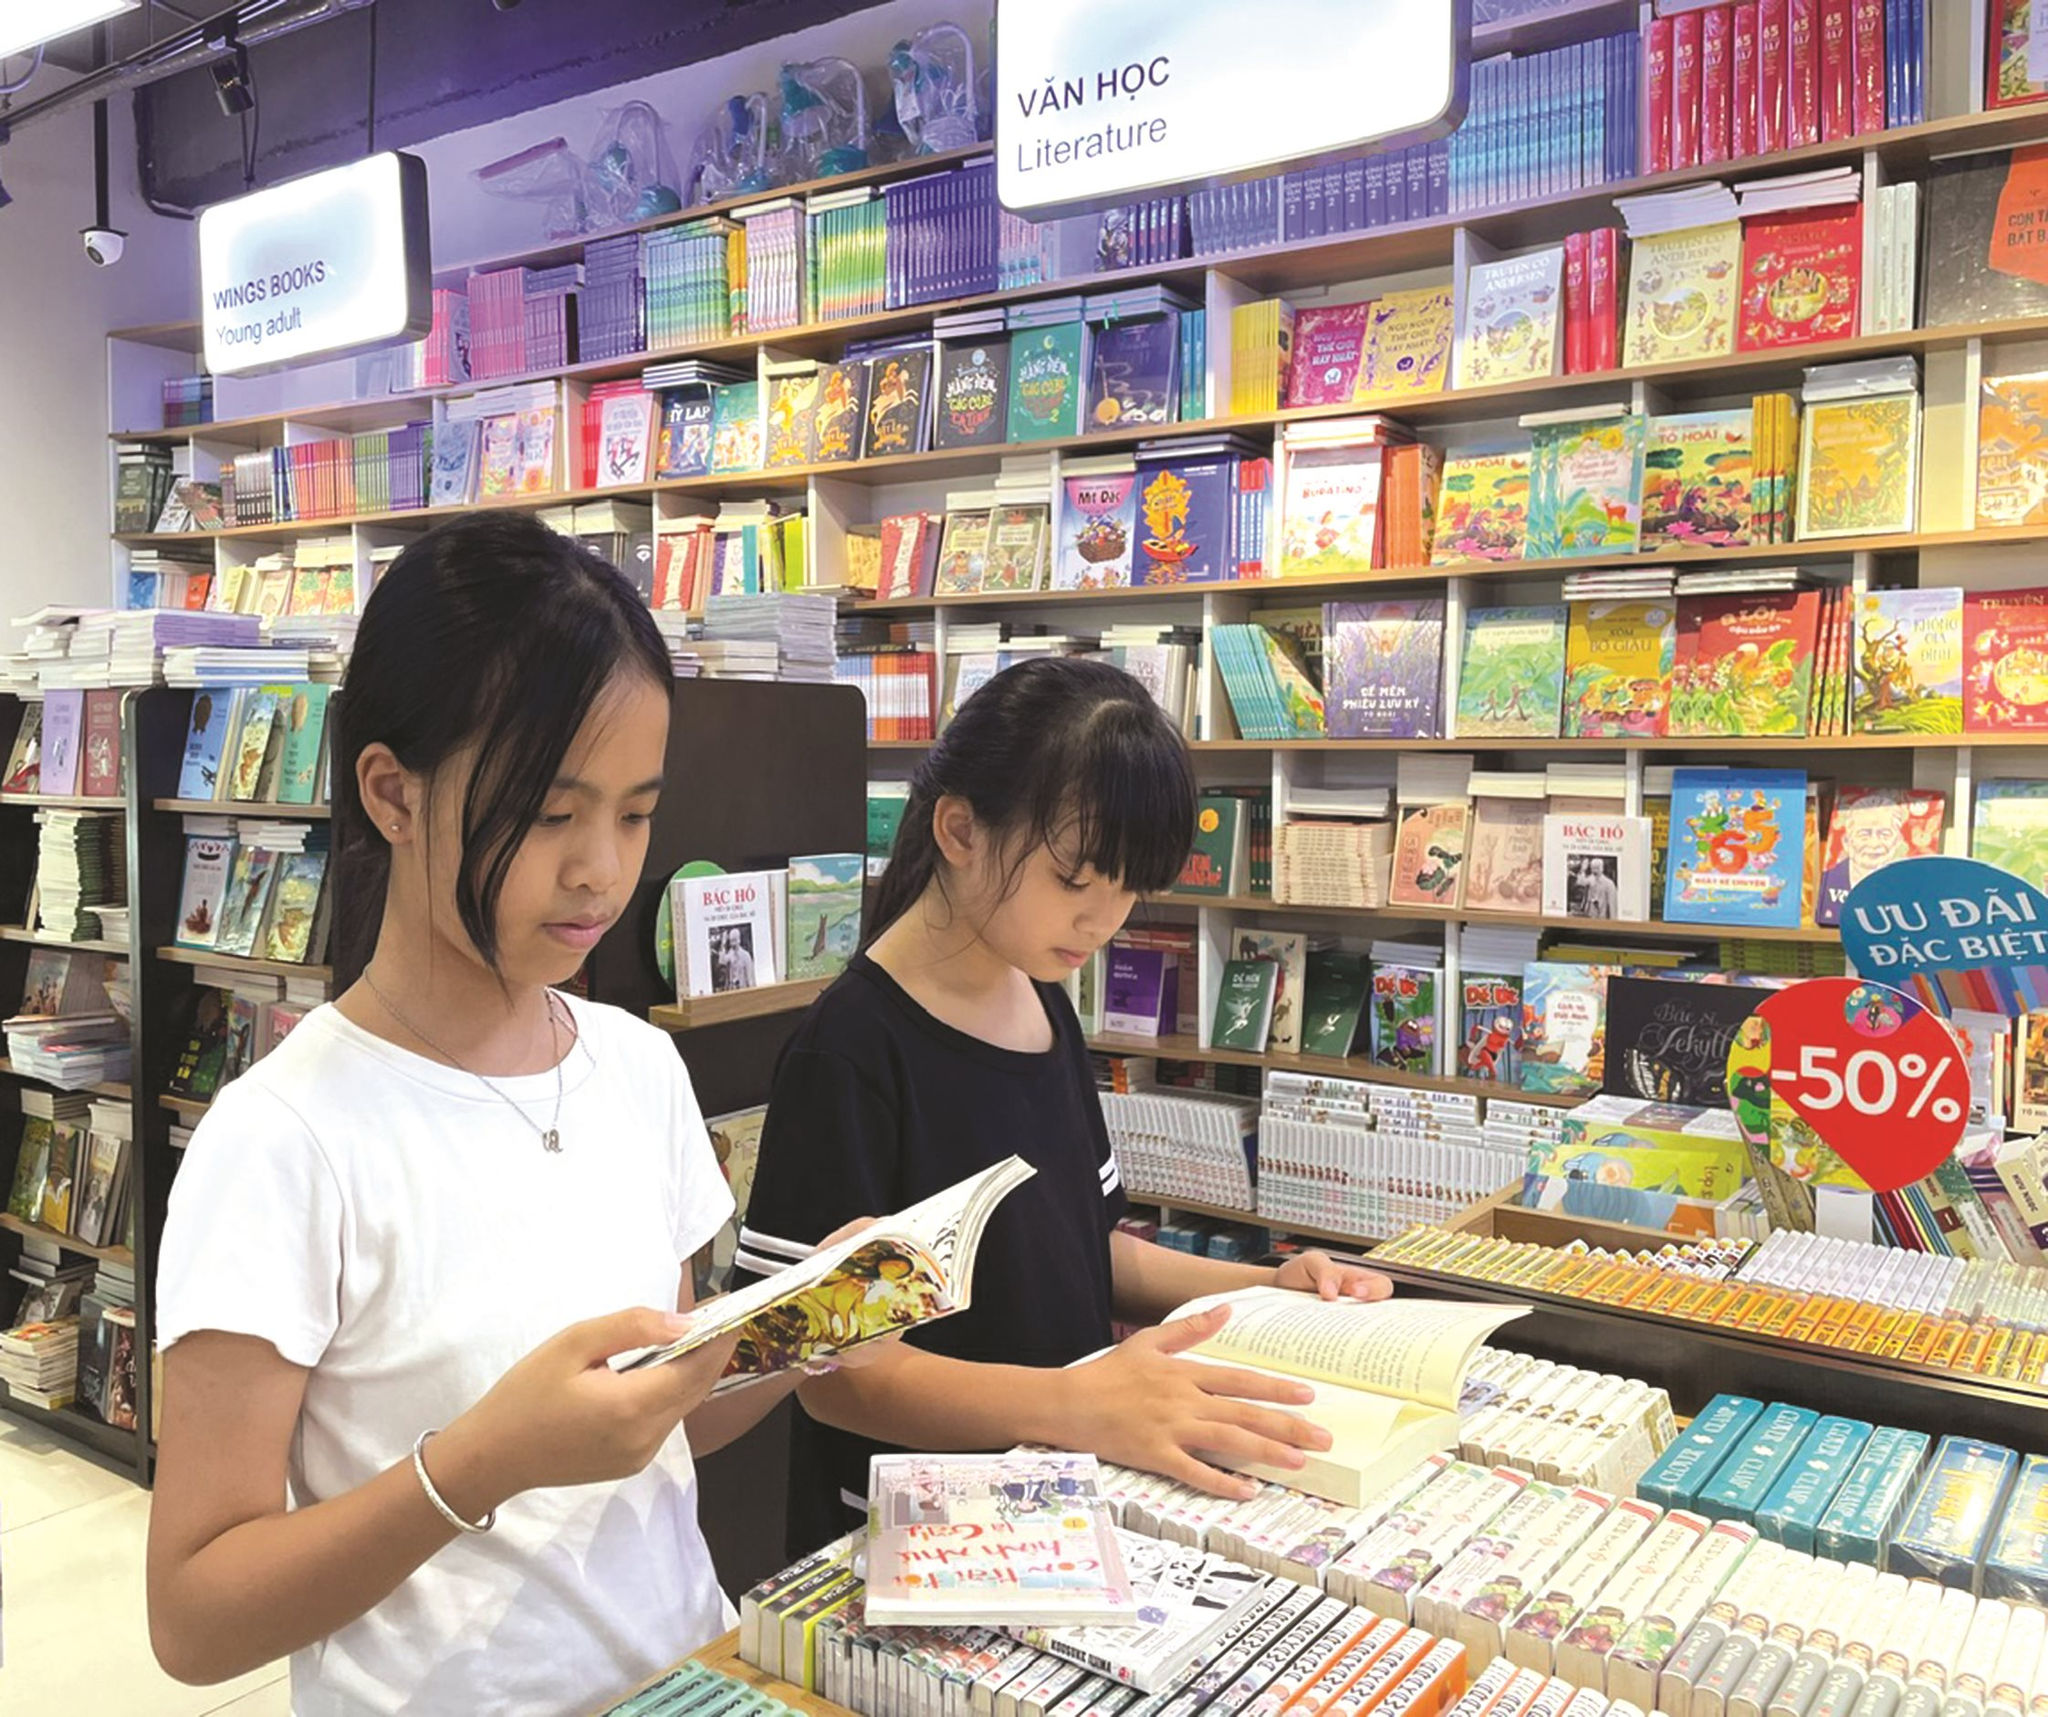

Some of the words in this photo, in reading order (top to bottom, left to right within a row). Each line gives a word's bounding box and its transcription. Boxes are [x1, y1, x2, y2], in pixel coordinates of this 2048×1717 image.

[1018, 76, 1083, 118] VĂN
[1098, 56, 1169, 101] HỌC
[1018, 118, 1167, 172] Literature
[213, 278, 266, 310] WINGS
[270, 260, 325, 297] BOOKS
[216, 322, 262, 345] Young
[266, 307, 302, 336] adult
[1854, 902, 1928, 935] ƯU
[1939, 888, 2037, 928] ĐÃI
[1868, 936, 1951, 968] ĐẶC
[1959, 928, 2048, 961] BIỆT
[1771, 1045, 1961, 1123] -50%
[1659, 1447, 1706, 1483] CLOVER
[1703, 1406, 1738, 1434] CLAMP
[1760, 1409, 1801, 1443] CLOVER
[1815, 1421, 1853, 1457] CLOVER
[1729, 1458, 1766, 1491] CLAMP
[1786, 1472, 1820, 1505] CLAMP
